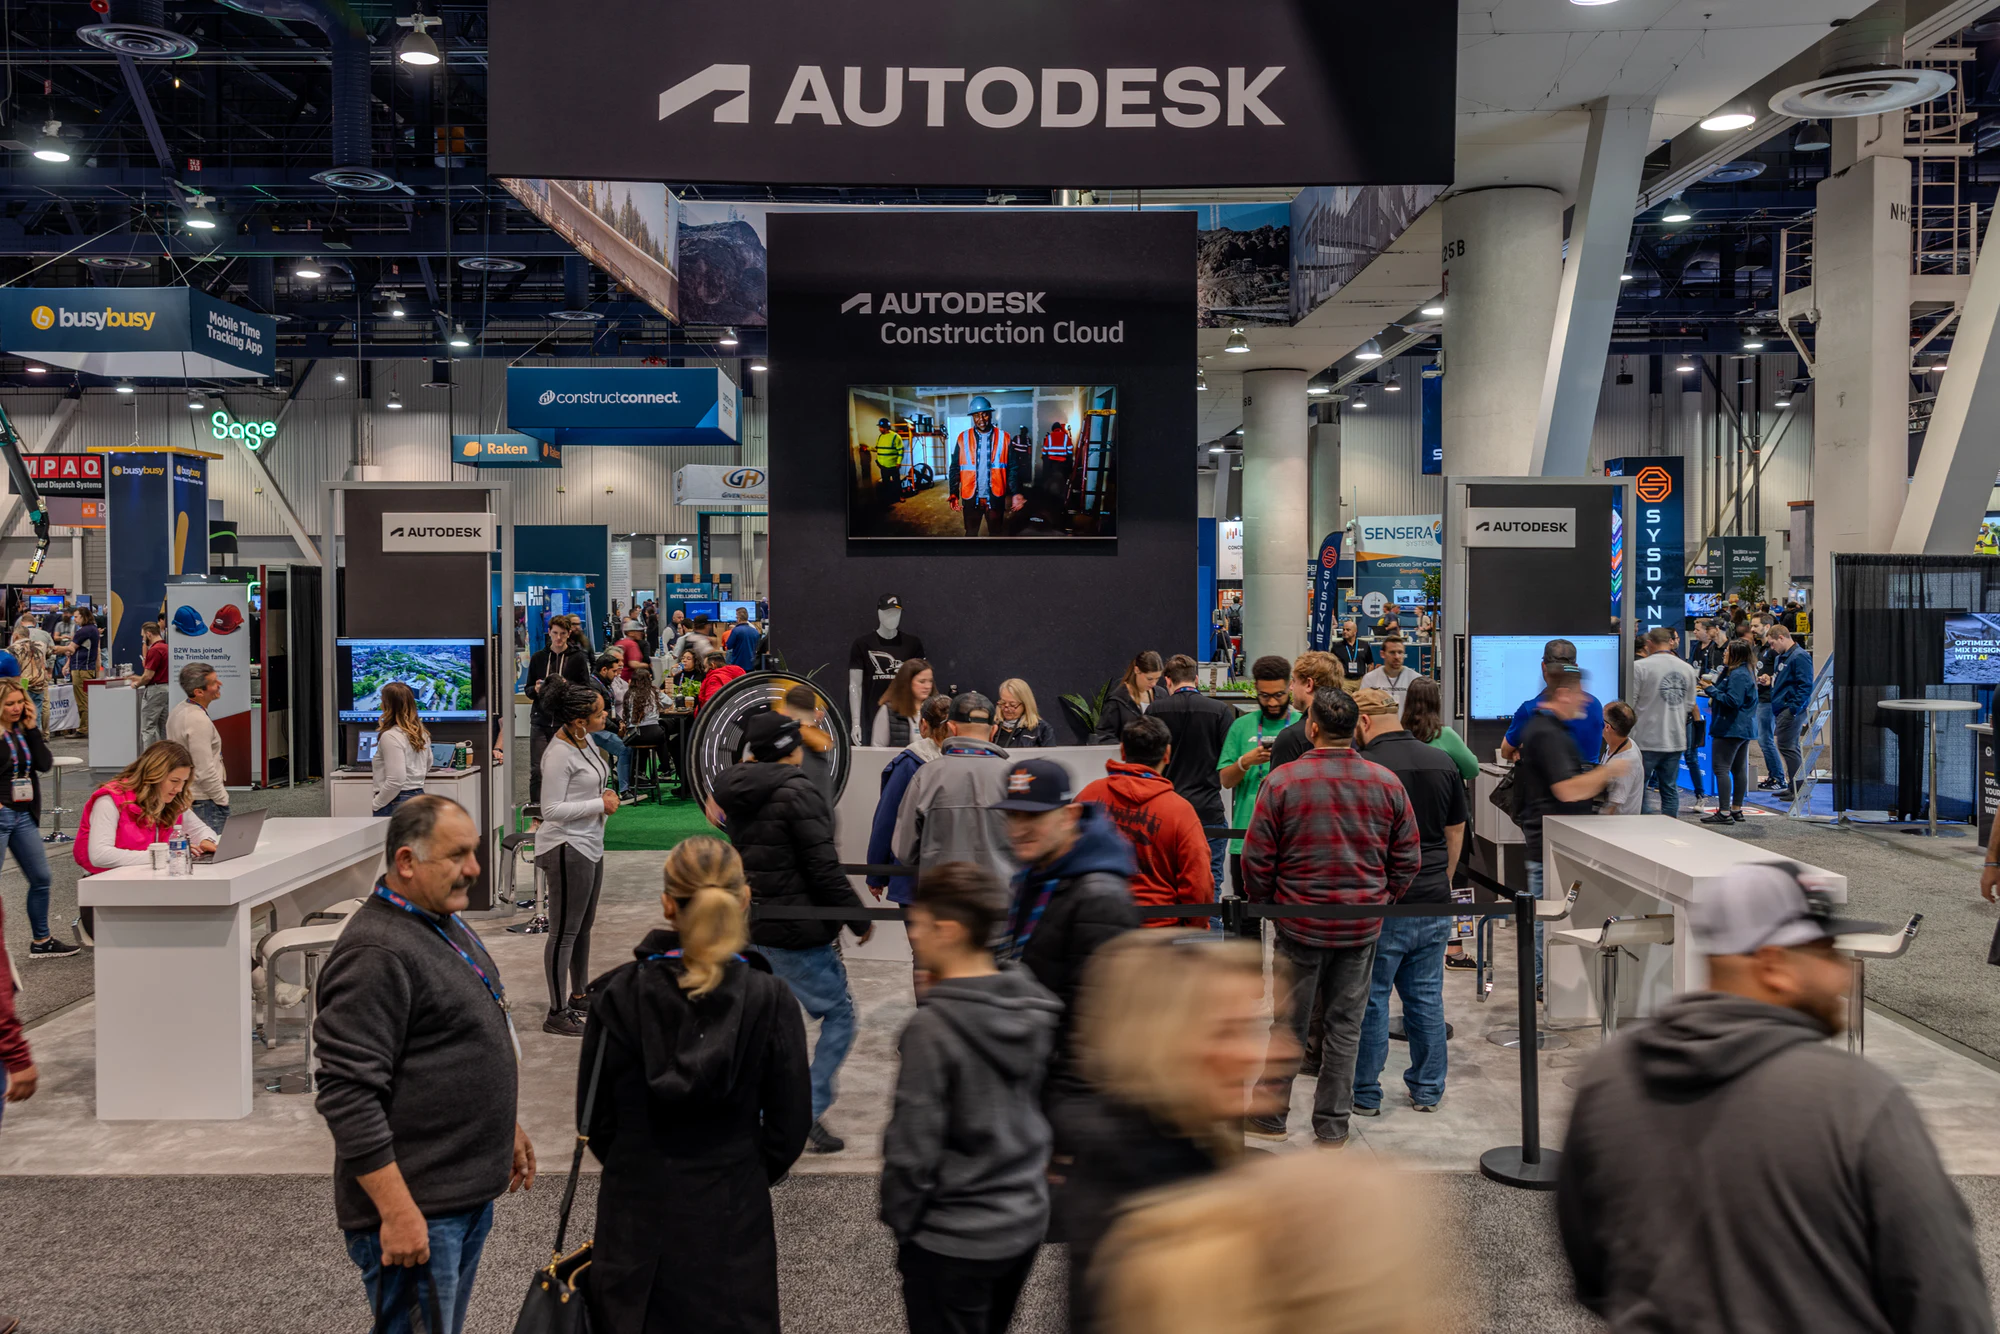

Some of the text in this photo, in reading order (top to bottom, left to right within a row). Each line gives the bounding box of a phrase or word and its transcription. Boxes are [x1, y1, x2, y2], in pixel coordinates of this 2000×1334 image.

[775, 66, 1285, 128] AUTODESK
[879, 291, 1046, 314] AUTODESK
[59, 307, 156, 331] busybusy
[208, 310, 261, 340] Mobile Time
[206, 324, 263, 356] Tracking App
[881, 321, 1124, 344] Construction Cloud
[211, 411, 277, 451] Sage
[487, 442, 528, 454] Raken
[122, 465, 165, 477] busybusy
[49, 481, 76, 490] Dispatch
[76, 481, 102, 490] Systems
[407, 527, 482, 538] AUTODESK
[1364, 526, 1433, 540] SENSERA
[1493, 521, 1568, 533] AUTODESK
[1316, 570, 1331, 643] SYSDYNE
[202, 647, 222, 655] joined
